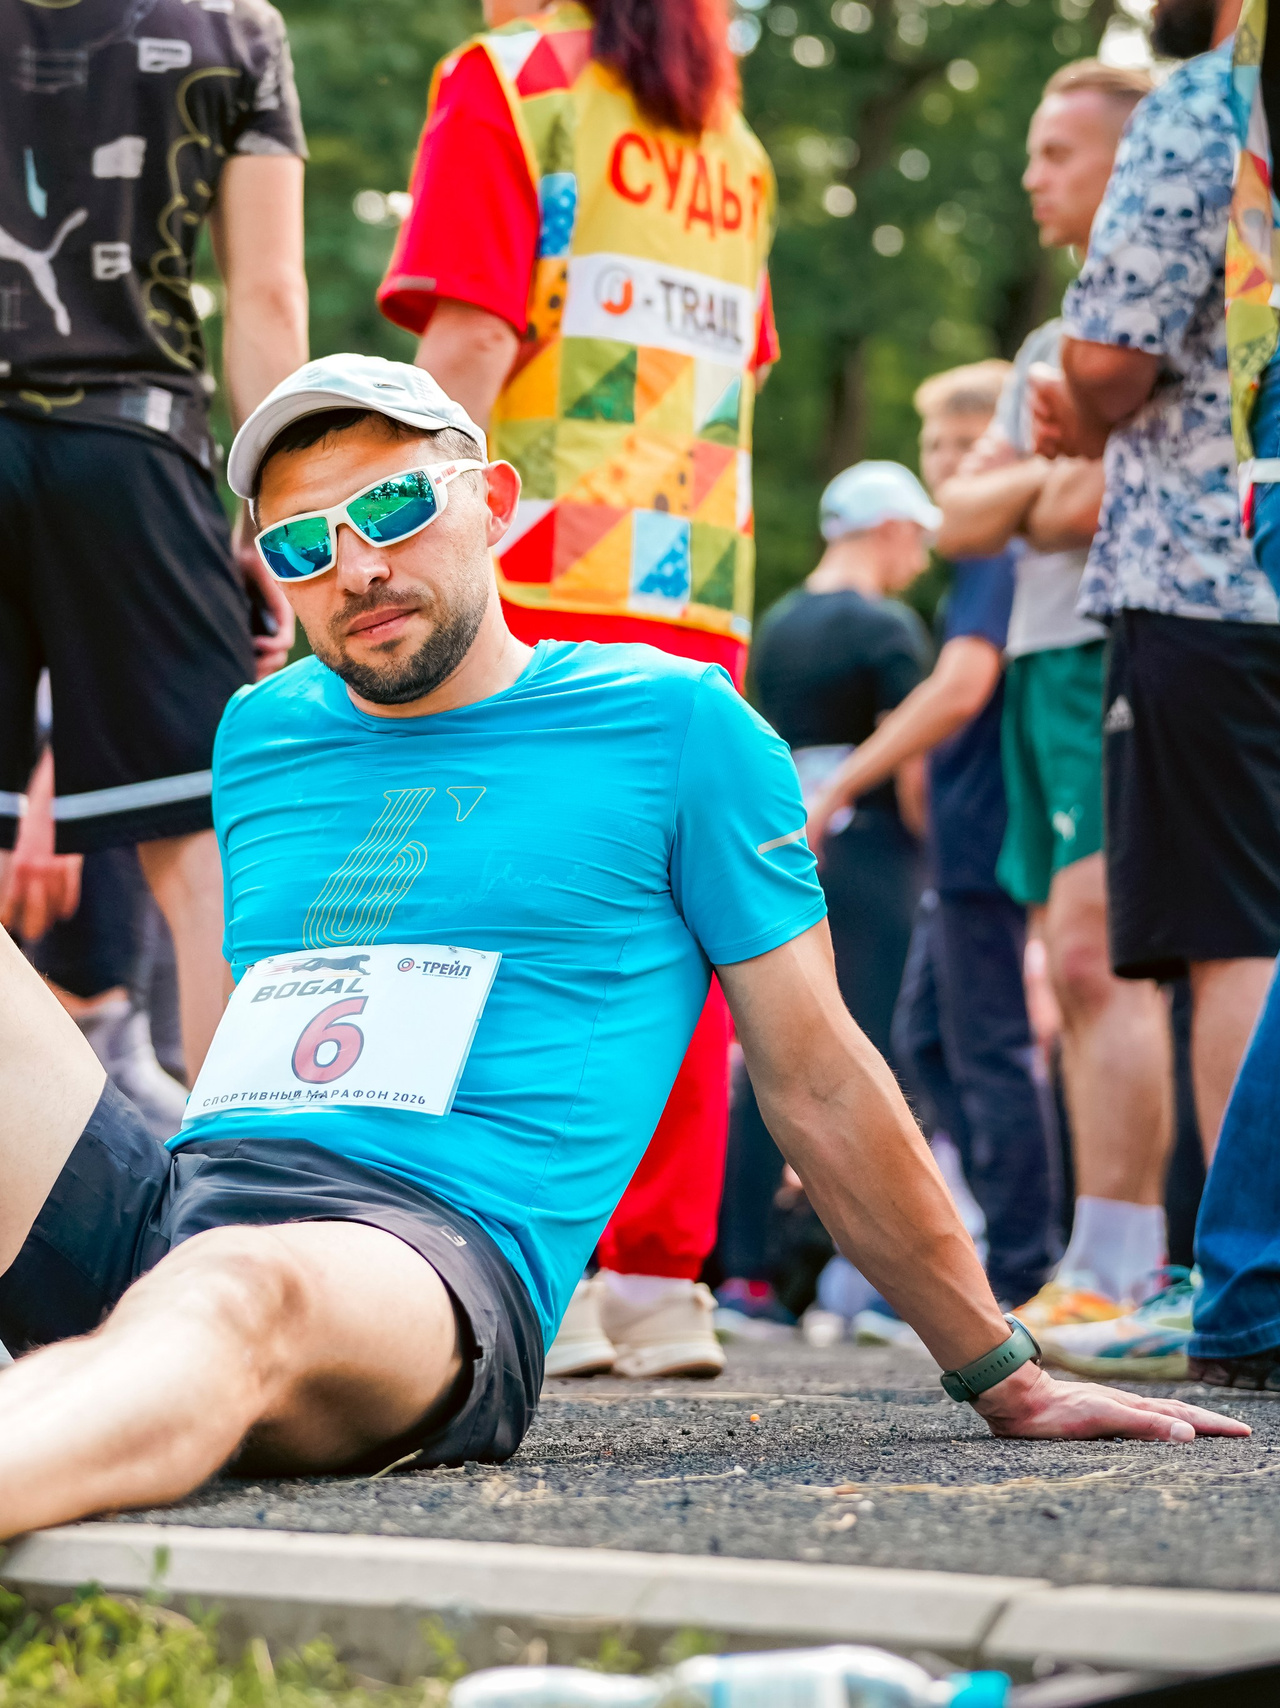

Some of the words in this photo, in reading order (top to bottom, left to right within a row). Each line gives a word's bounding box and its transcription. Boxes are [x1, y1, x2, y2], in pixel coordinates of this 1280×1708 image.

[250, 977, 365, 1003] BOGAL
[291, 995, 369, 1084] 6
[202, 1089, 303, 1107] СПОРТИВНЫЙ
[306, 1089, 389, 1102] МАРАФОН
[392, 1091, 426, 1105] 2026
